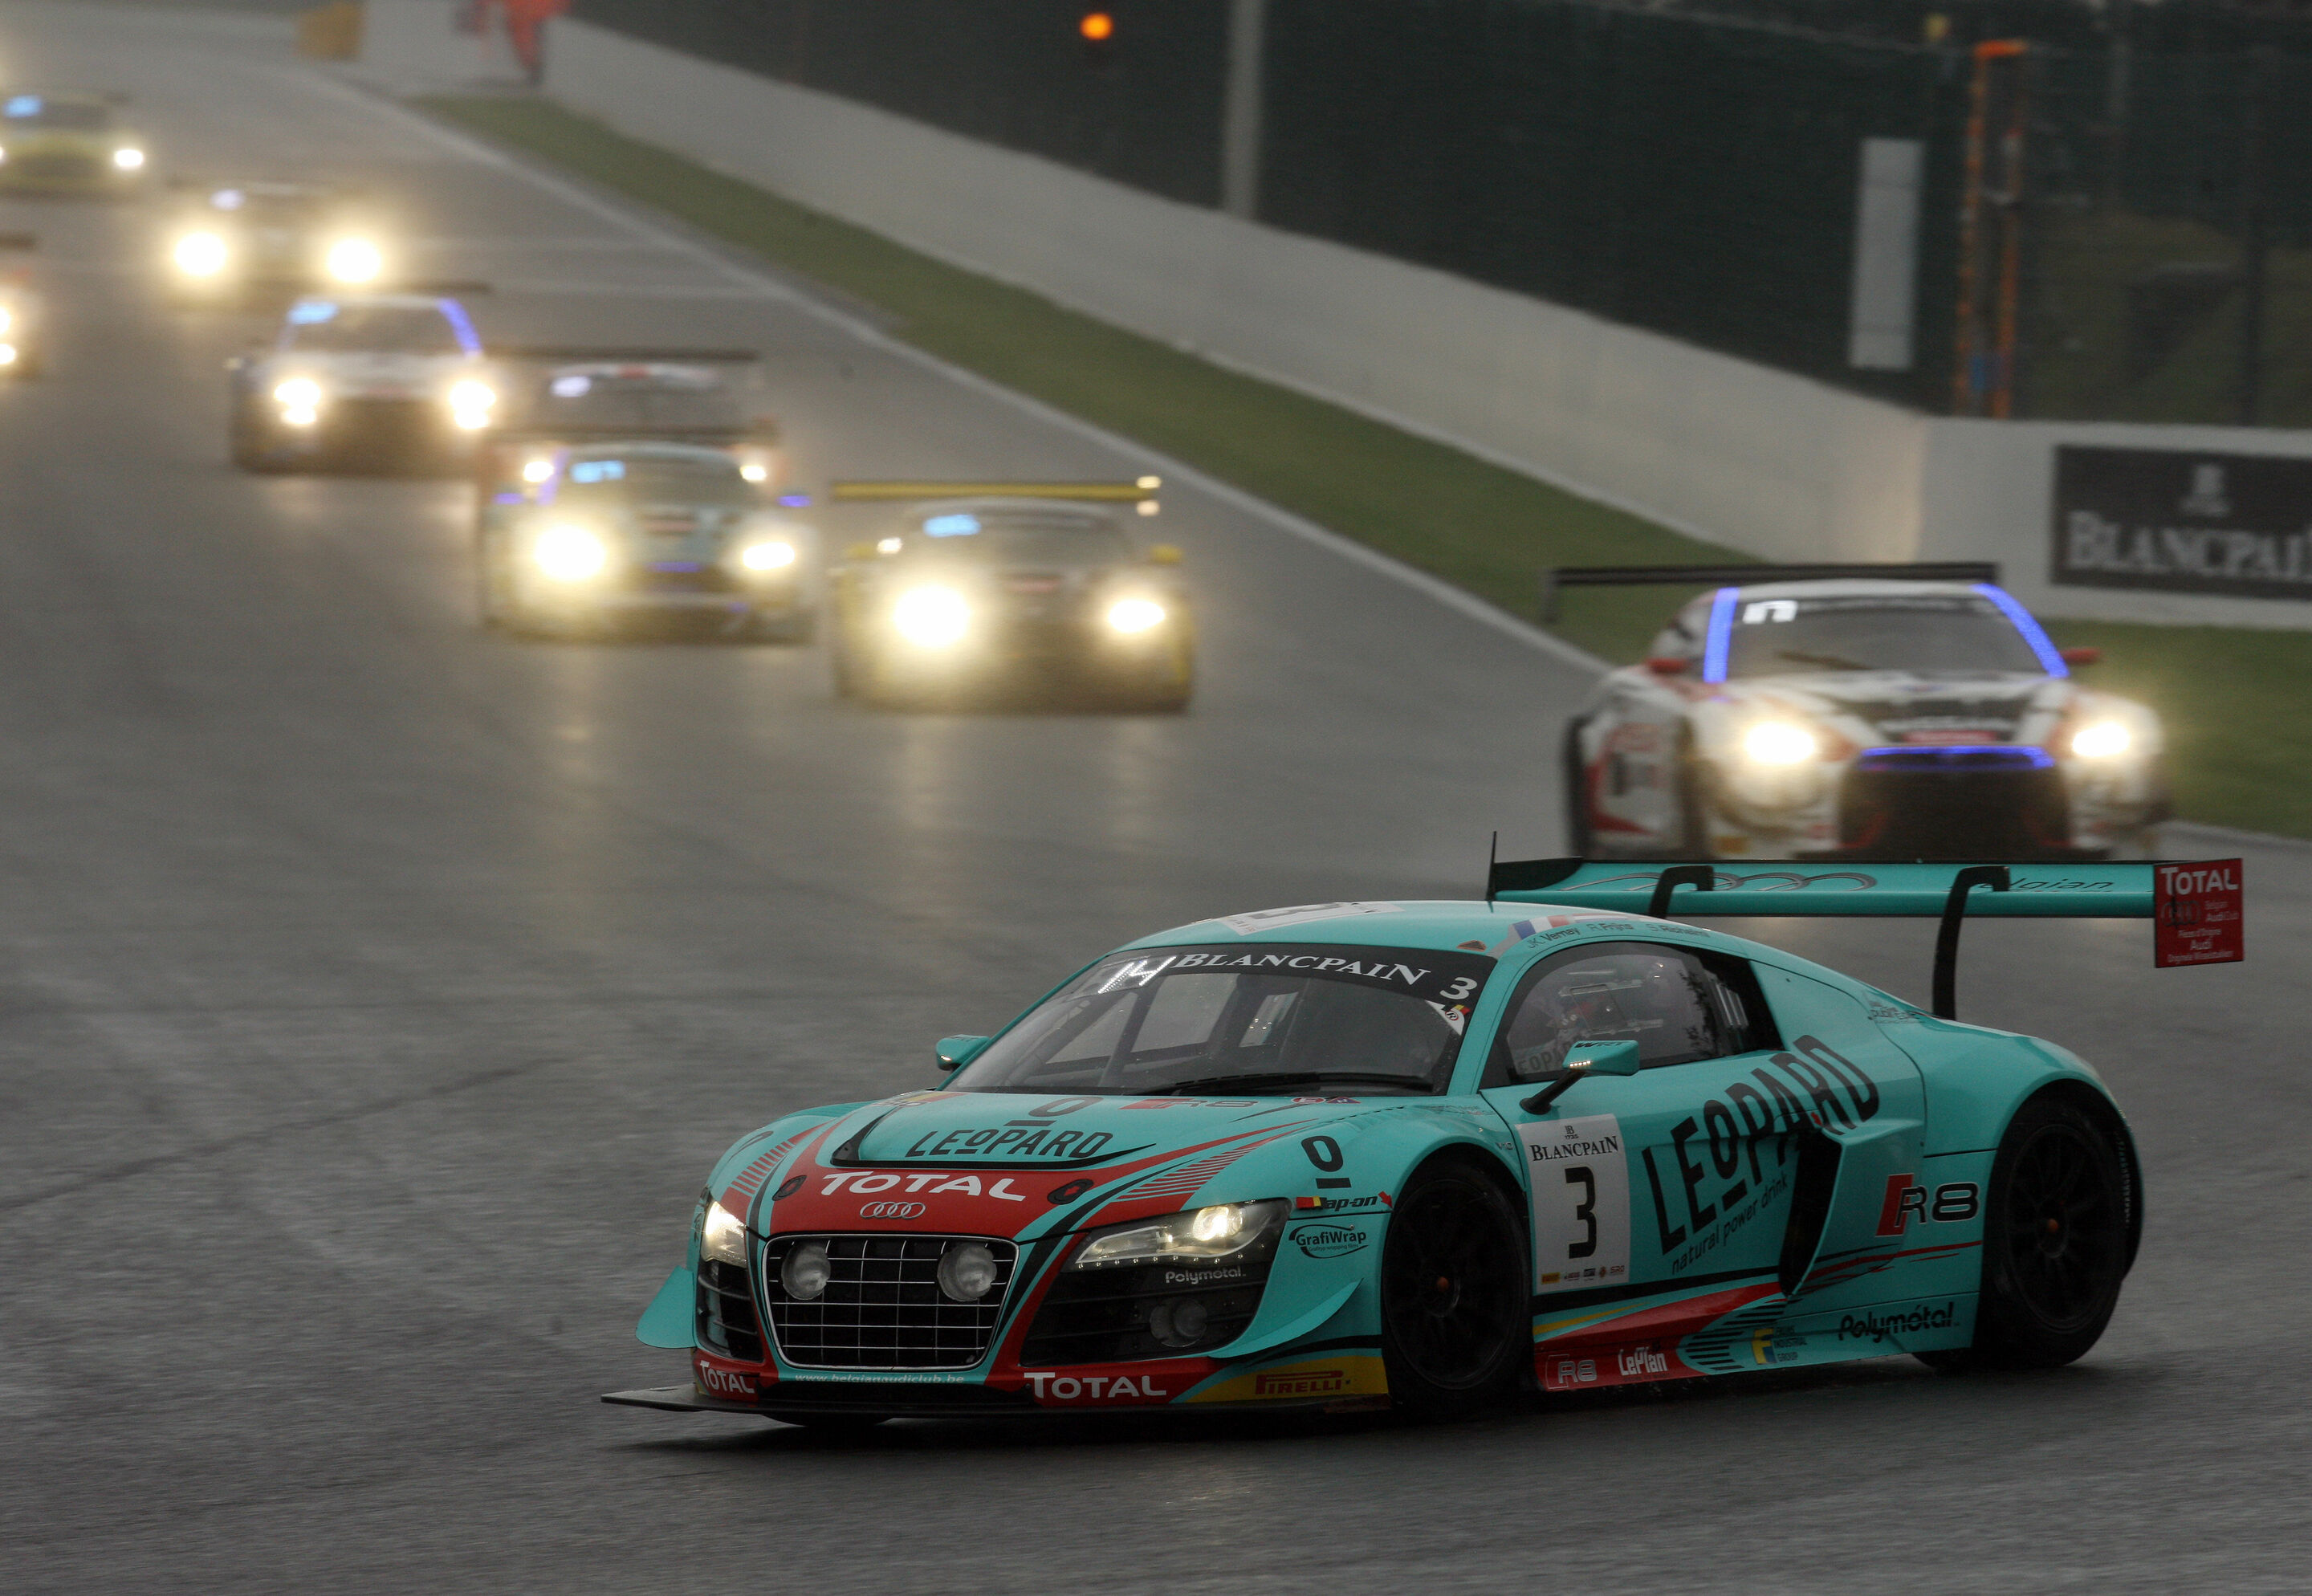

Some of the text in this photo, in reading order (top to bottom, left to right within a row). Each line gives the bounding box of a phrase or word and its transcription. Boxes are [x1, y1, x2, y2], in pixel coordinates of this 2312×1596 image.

[2066, 509, 2312, 584] BLANCPAI
[2160, 866, 2239, 896] TOTAL
[1170, 952, 1431, 987] BLANCPAIN
[1439, 976, 1478, 1000] 3
[904, 1128, 1113, 1159] LEOPARD
[1528, 1135, 1619, 1162] BLANCPAIN
[1642, 1034, 1880, 1256] LEOPARD
[820, 1171, 1026, 1202] TOTAL
[1564, 1166, 1598, 1260] 3
[1895, 1182, 1980, 1228] R8
[1295, 1230, 1367, 1247] GrafiWrap
[1671, 1172, 1788, 1275] natural power drink
[699, 1359, 756, 1394] TOTAL
[1557, 1359, 1598, 1384] R8
[1617, 1346, 1669, 1376] LePlan
[1023, 1371, 1167, 1400] TOTAL
[1254, 1370, 1345, 1395] PIRELLI
